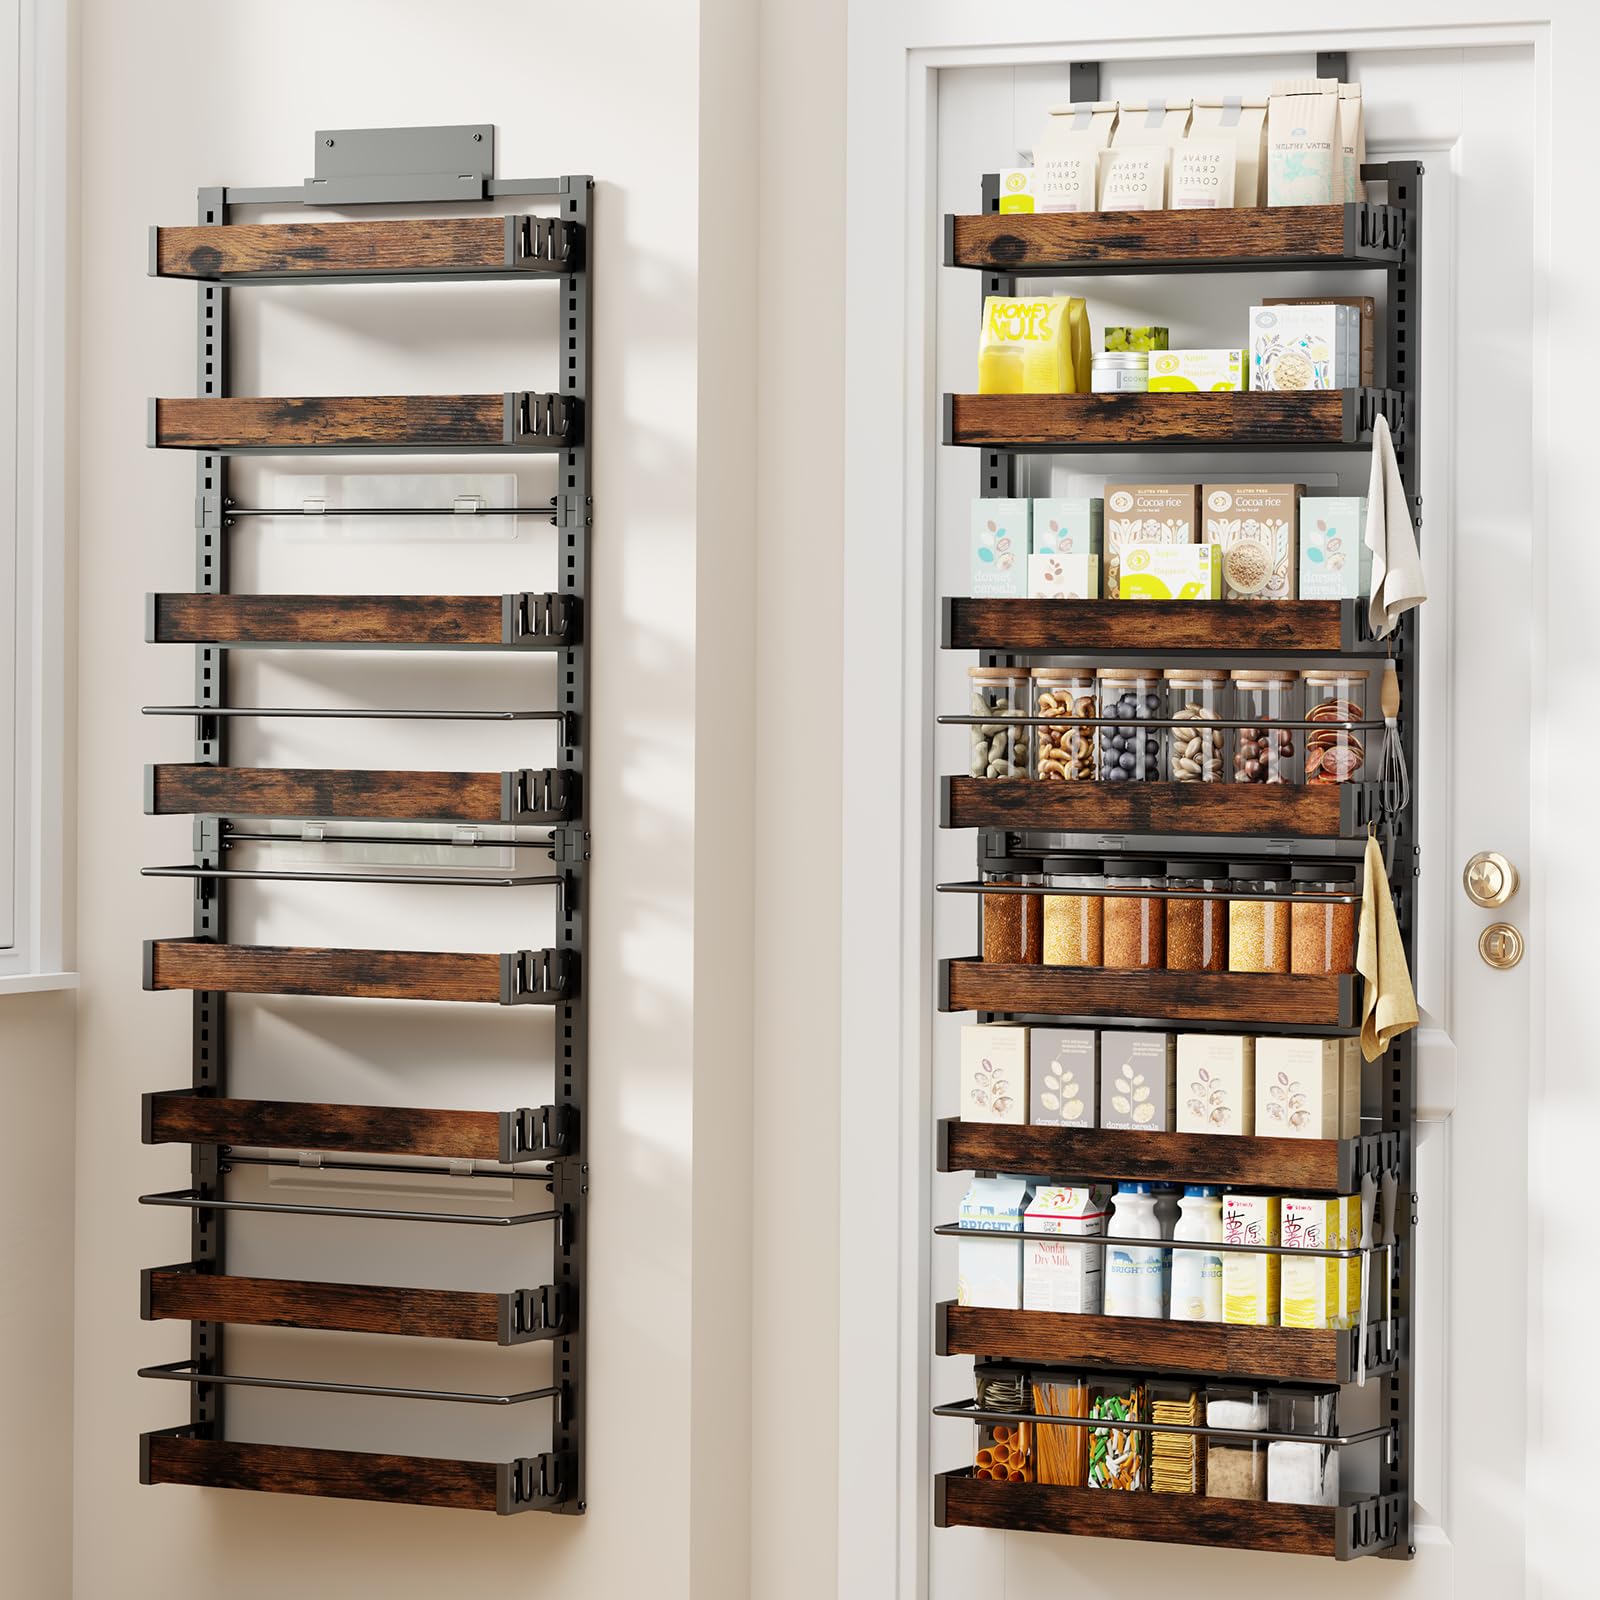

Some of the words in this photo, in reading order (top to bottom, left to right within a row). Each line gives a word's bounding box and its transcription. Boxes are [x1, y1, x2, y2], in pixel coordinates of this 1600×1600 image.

[991, 303, 1057, 319] HONEY
[1136, 498, 1164, 507] Cocoa
[1165, 497, 1182, 507] rice
[1235, 497, 1263, 507] Cocoa
[1264, 497, 1281, 506] rice
[960, 1219, 1011, 1232] BRIGHT
[1039, 1242, 1065, 1255] Nonfat
[1034, 1254, 1049, 1266] Dry
[1051, 1255, 1070, 1266] Milk
[1111, 1265, 1144, 1274] BRIGHT
[1200, 1270, 1222, 1278] BRIG
